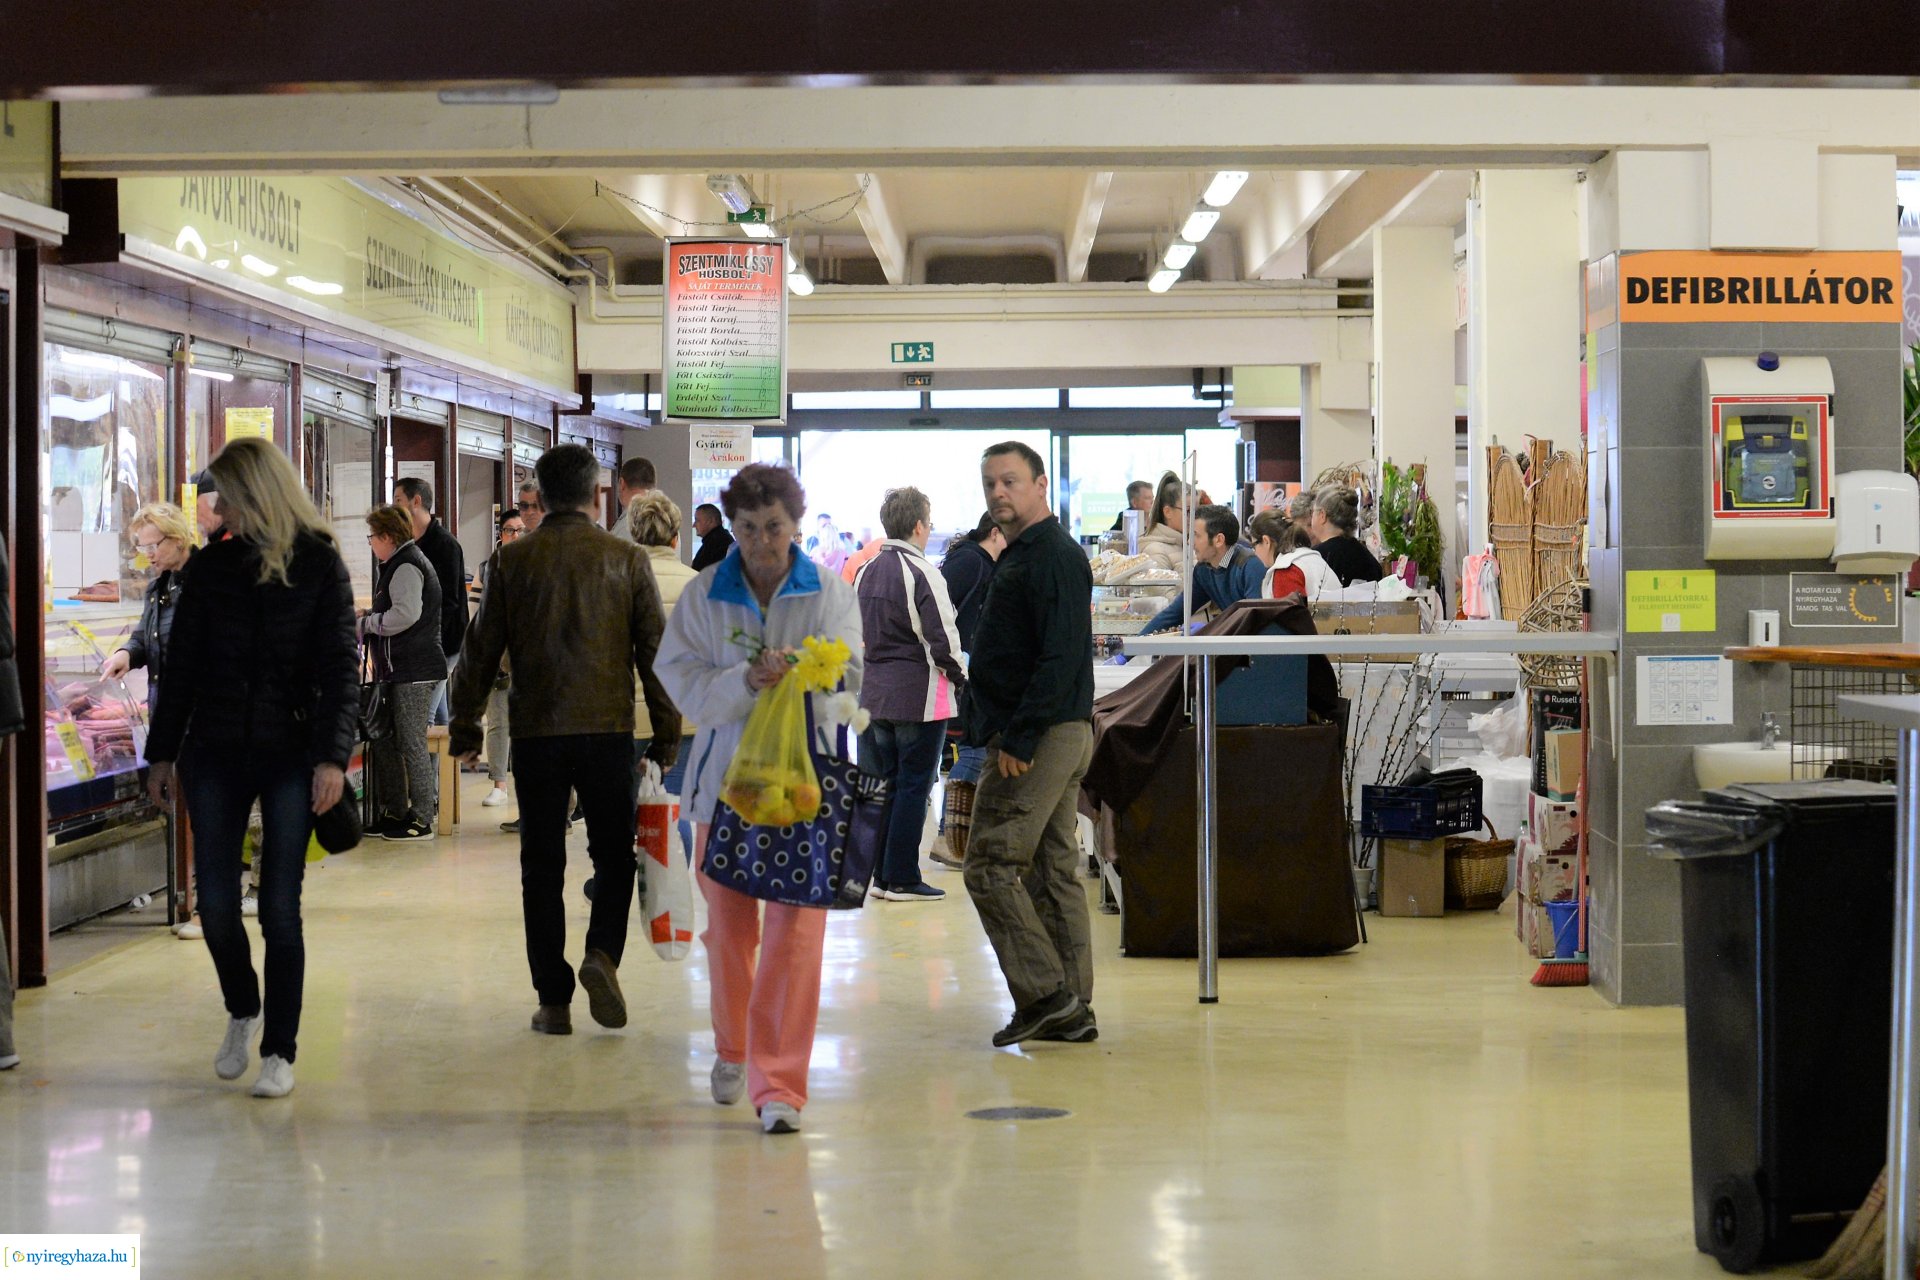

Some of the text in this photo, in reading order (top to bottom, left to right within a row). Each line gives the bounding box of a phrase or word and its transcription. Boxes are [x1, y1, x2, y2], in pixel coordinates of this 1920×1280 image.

[698, 268, 752, 279] HÚSBOLT
[1626, 269, 1894, 305] DEFIBRILLÁTOR
[441, 264, 476, 329] HÚSBOLT
[677, 292, 743, 301] Füstölt Csülök
[677, 304, 736, 313] Füstölt Tarja
[710, 316, 737, 325] Karaj
[710, 338, 749, 346] Kolbász
[676, 349, 726, 357] Kolozsvári
[676, 360, 725, 369] Füstölt Fej
[695, 371, 734, 379] Császár
[907, 376, 930, 385] EXIT
[695, 382, 710, 391] Fej
[675, 393, 708, 403] Erdélyi
[696, 439, 732, 451] Gyártói
[1551, 694, 1577, 704] Russell
